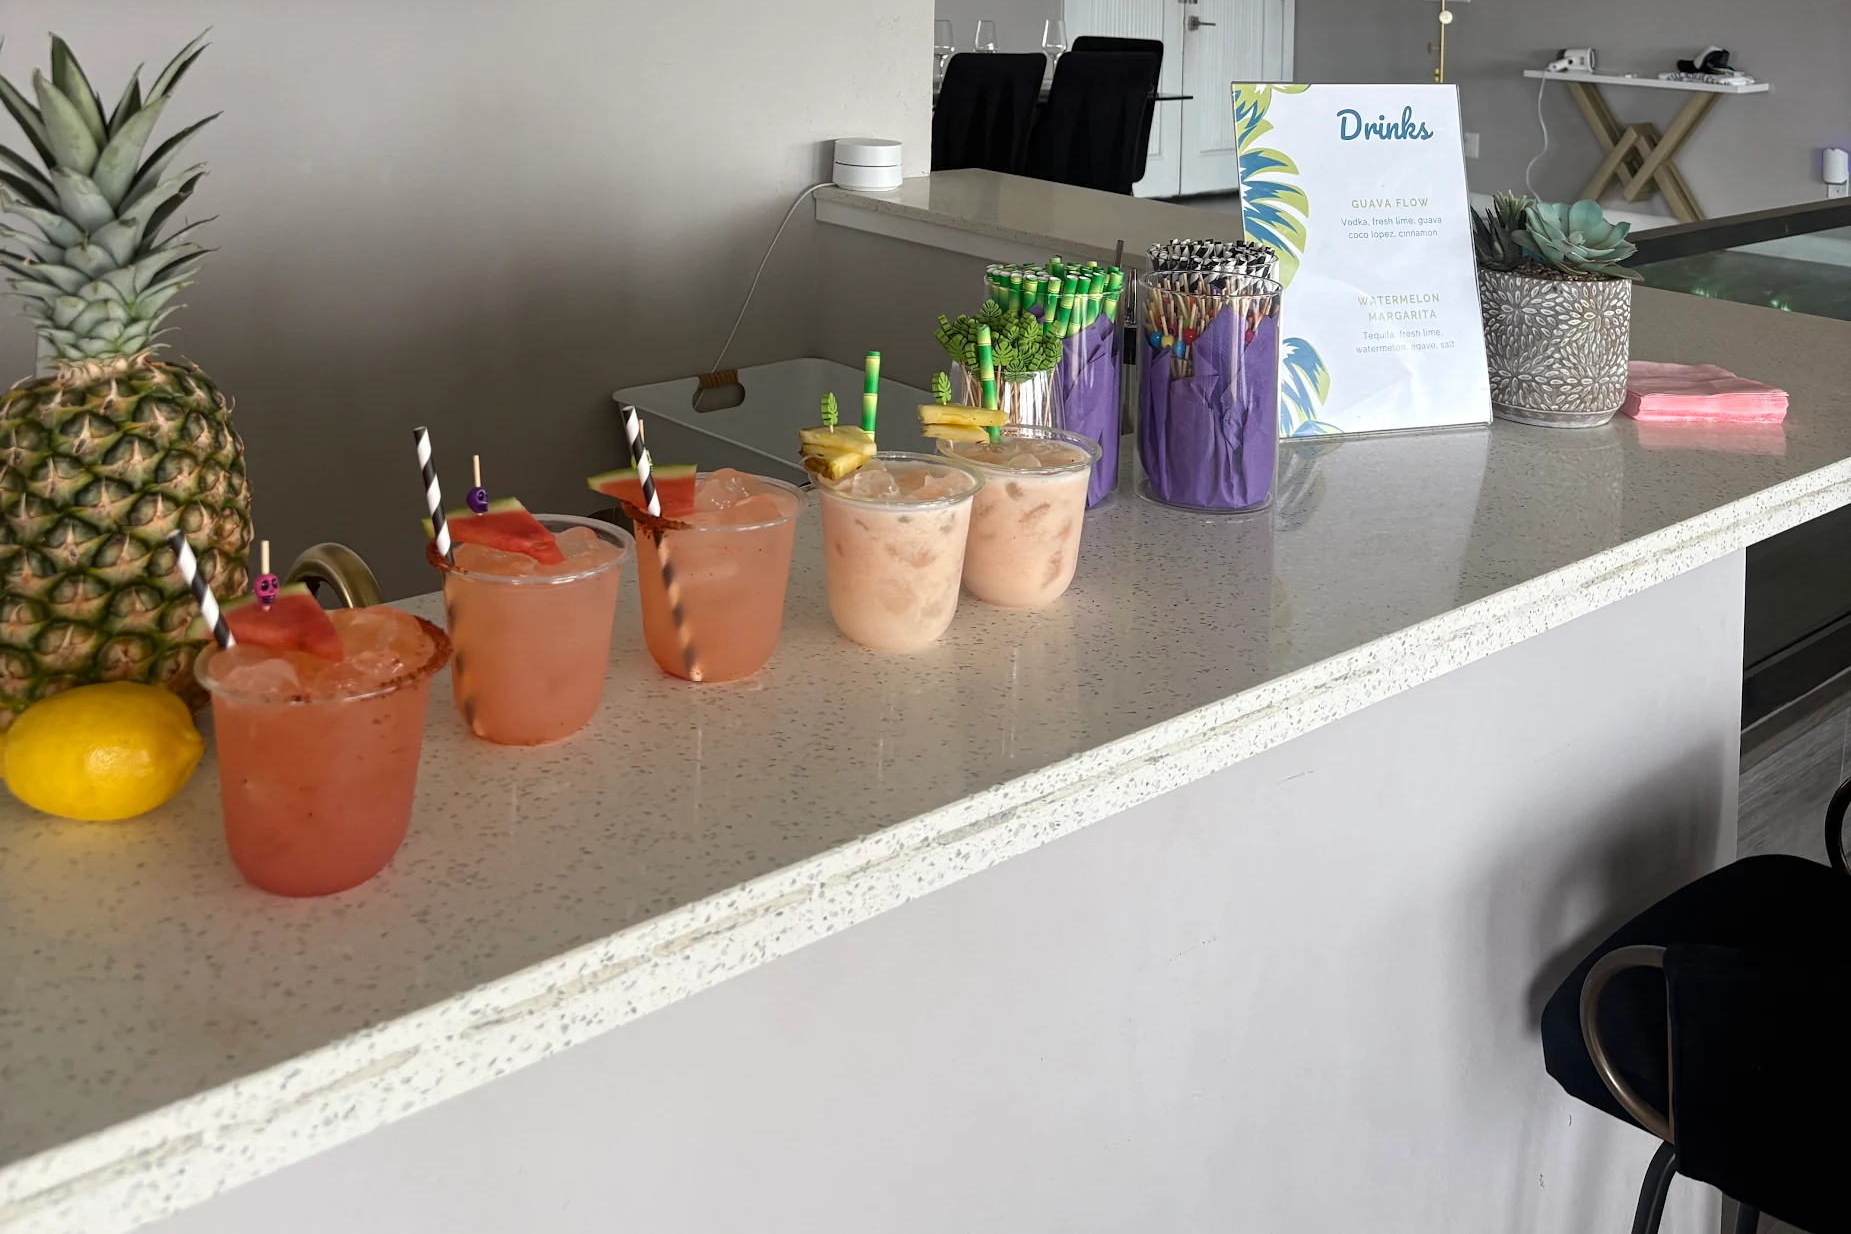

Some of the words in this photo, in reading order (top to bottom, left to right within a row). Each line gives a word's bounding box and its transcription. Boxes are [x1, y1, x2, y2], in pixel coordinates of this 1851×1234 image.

[1336, 105, 1434, 141] Drinks
[1351, 199, 1392, 209] GUAVA
[1395, 198, 1429, 207] FLOW
[1372, 217, 1393, 226] fresh
[1417, 216, 1442, 226] guava
[1348, 231, 1369, 239] coco
[1398, 229, 1438, 238] cinnamon
[1357, 293, 1440, 306] WATERMELON
[1368, 309, 1437, 322] MARGARITA
[1399, 329, 1421, 338] fresh
[1440, 340, 1455, 349] salt
